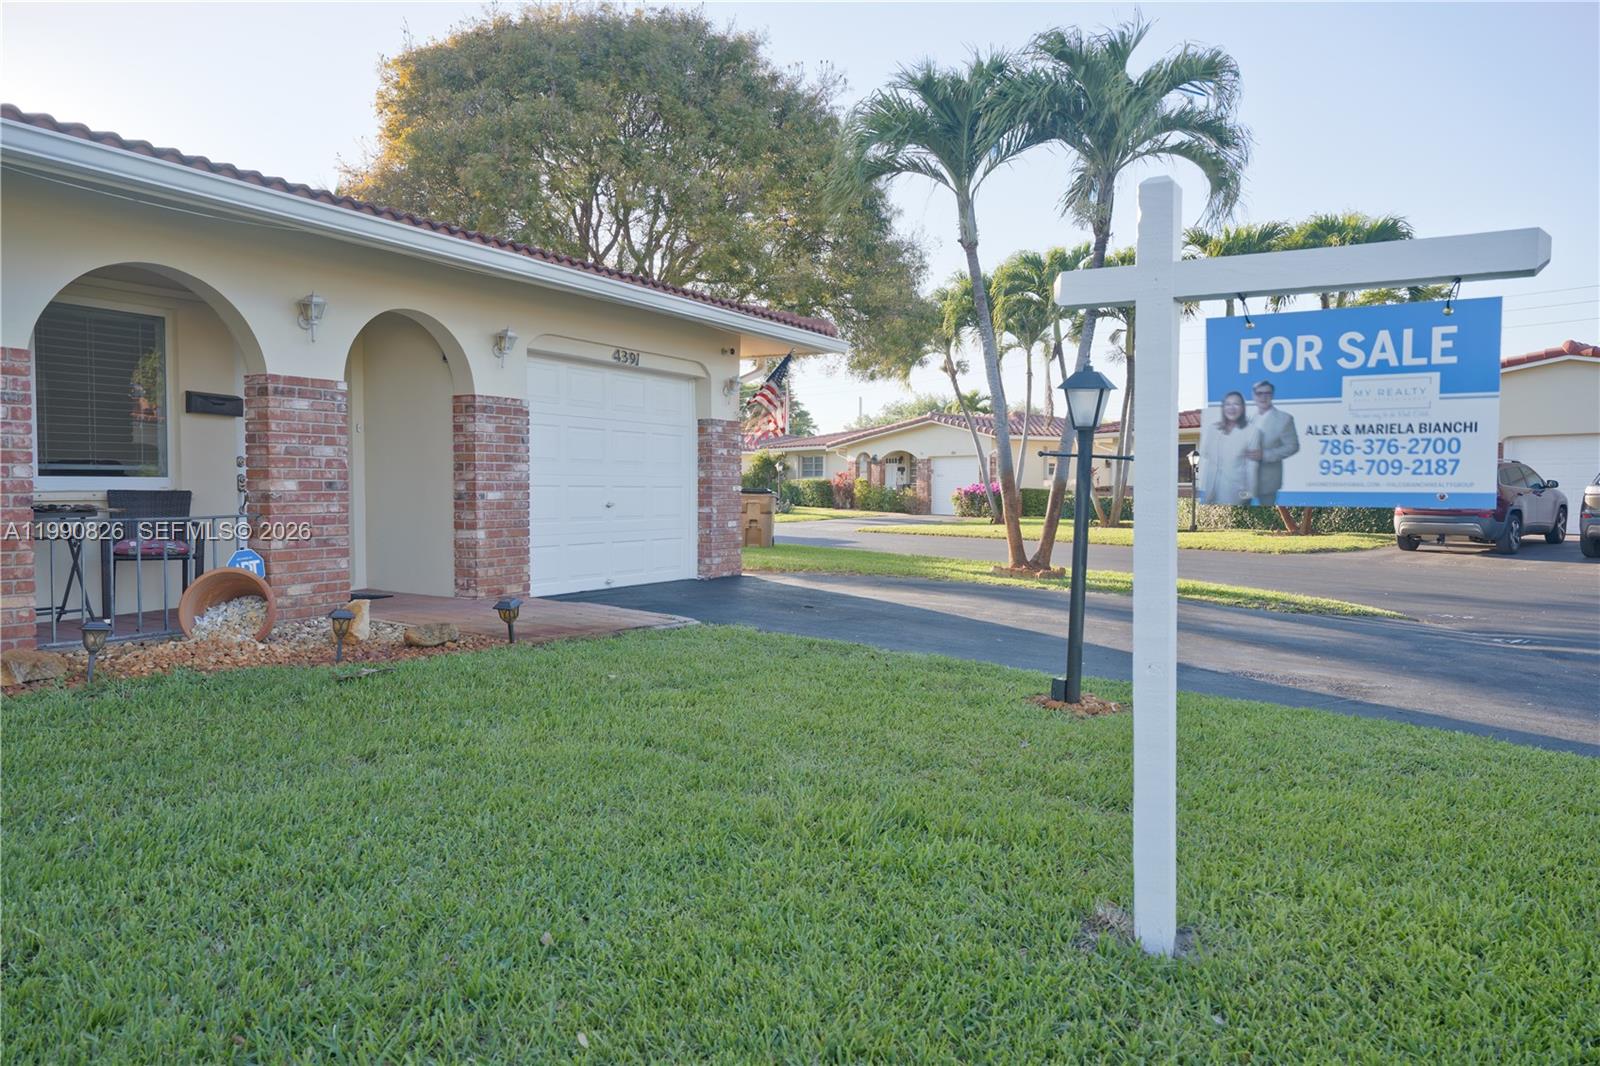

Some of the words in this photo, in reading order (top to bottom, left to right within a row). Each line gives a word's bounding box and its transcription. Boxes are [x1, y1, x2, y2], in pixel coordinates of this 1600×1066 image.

[612, 349, 640, 366] 4391
[1239, 334, 1323, 374] FOR
[1336, 325, 1458, 369] SALE
[1353, 387, 1372, 397] MY
[1377, 386, 1427, 397] REALTY
[1305, 424, 1338, 436] ALEX
[1341, 424, 1351, 436] &
[1355, 422, 1415, 435] MARIELA
[1418, 421, 1479, 434] BIANCHI
[1319, 437, 1462, 456] 786-376-2700
[1319, 458, 1461, 476] 954-709-2187
